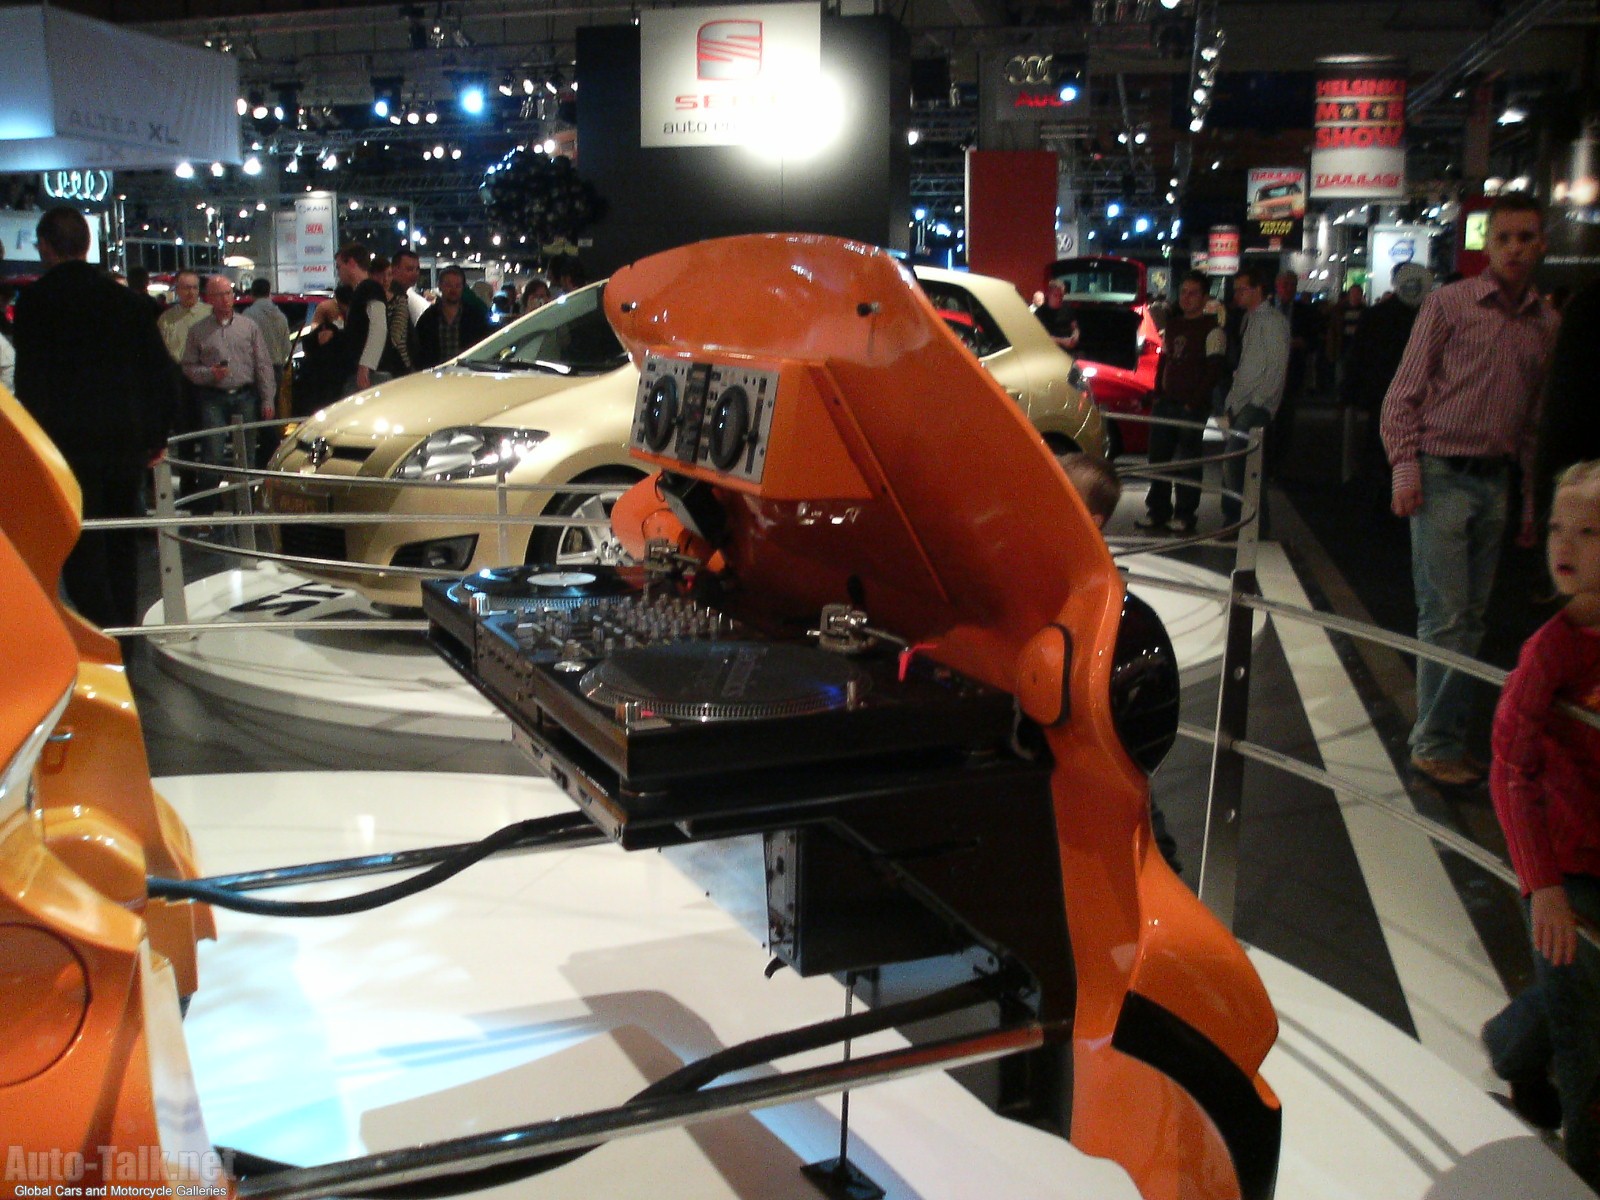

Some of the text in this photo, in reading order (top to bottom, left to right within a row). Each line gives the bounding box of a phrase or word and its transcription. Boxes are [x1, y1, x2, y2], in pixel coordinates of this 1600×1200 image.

[147, 121, 181, 145] XL
[663, 120, 707, 135] auto
[1315, 127, 1405, 149] SHOW
